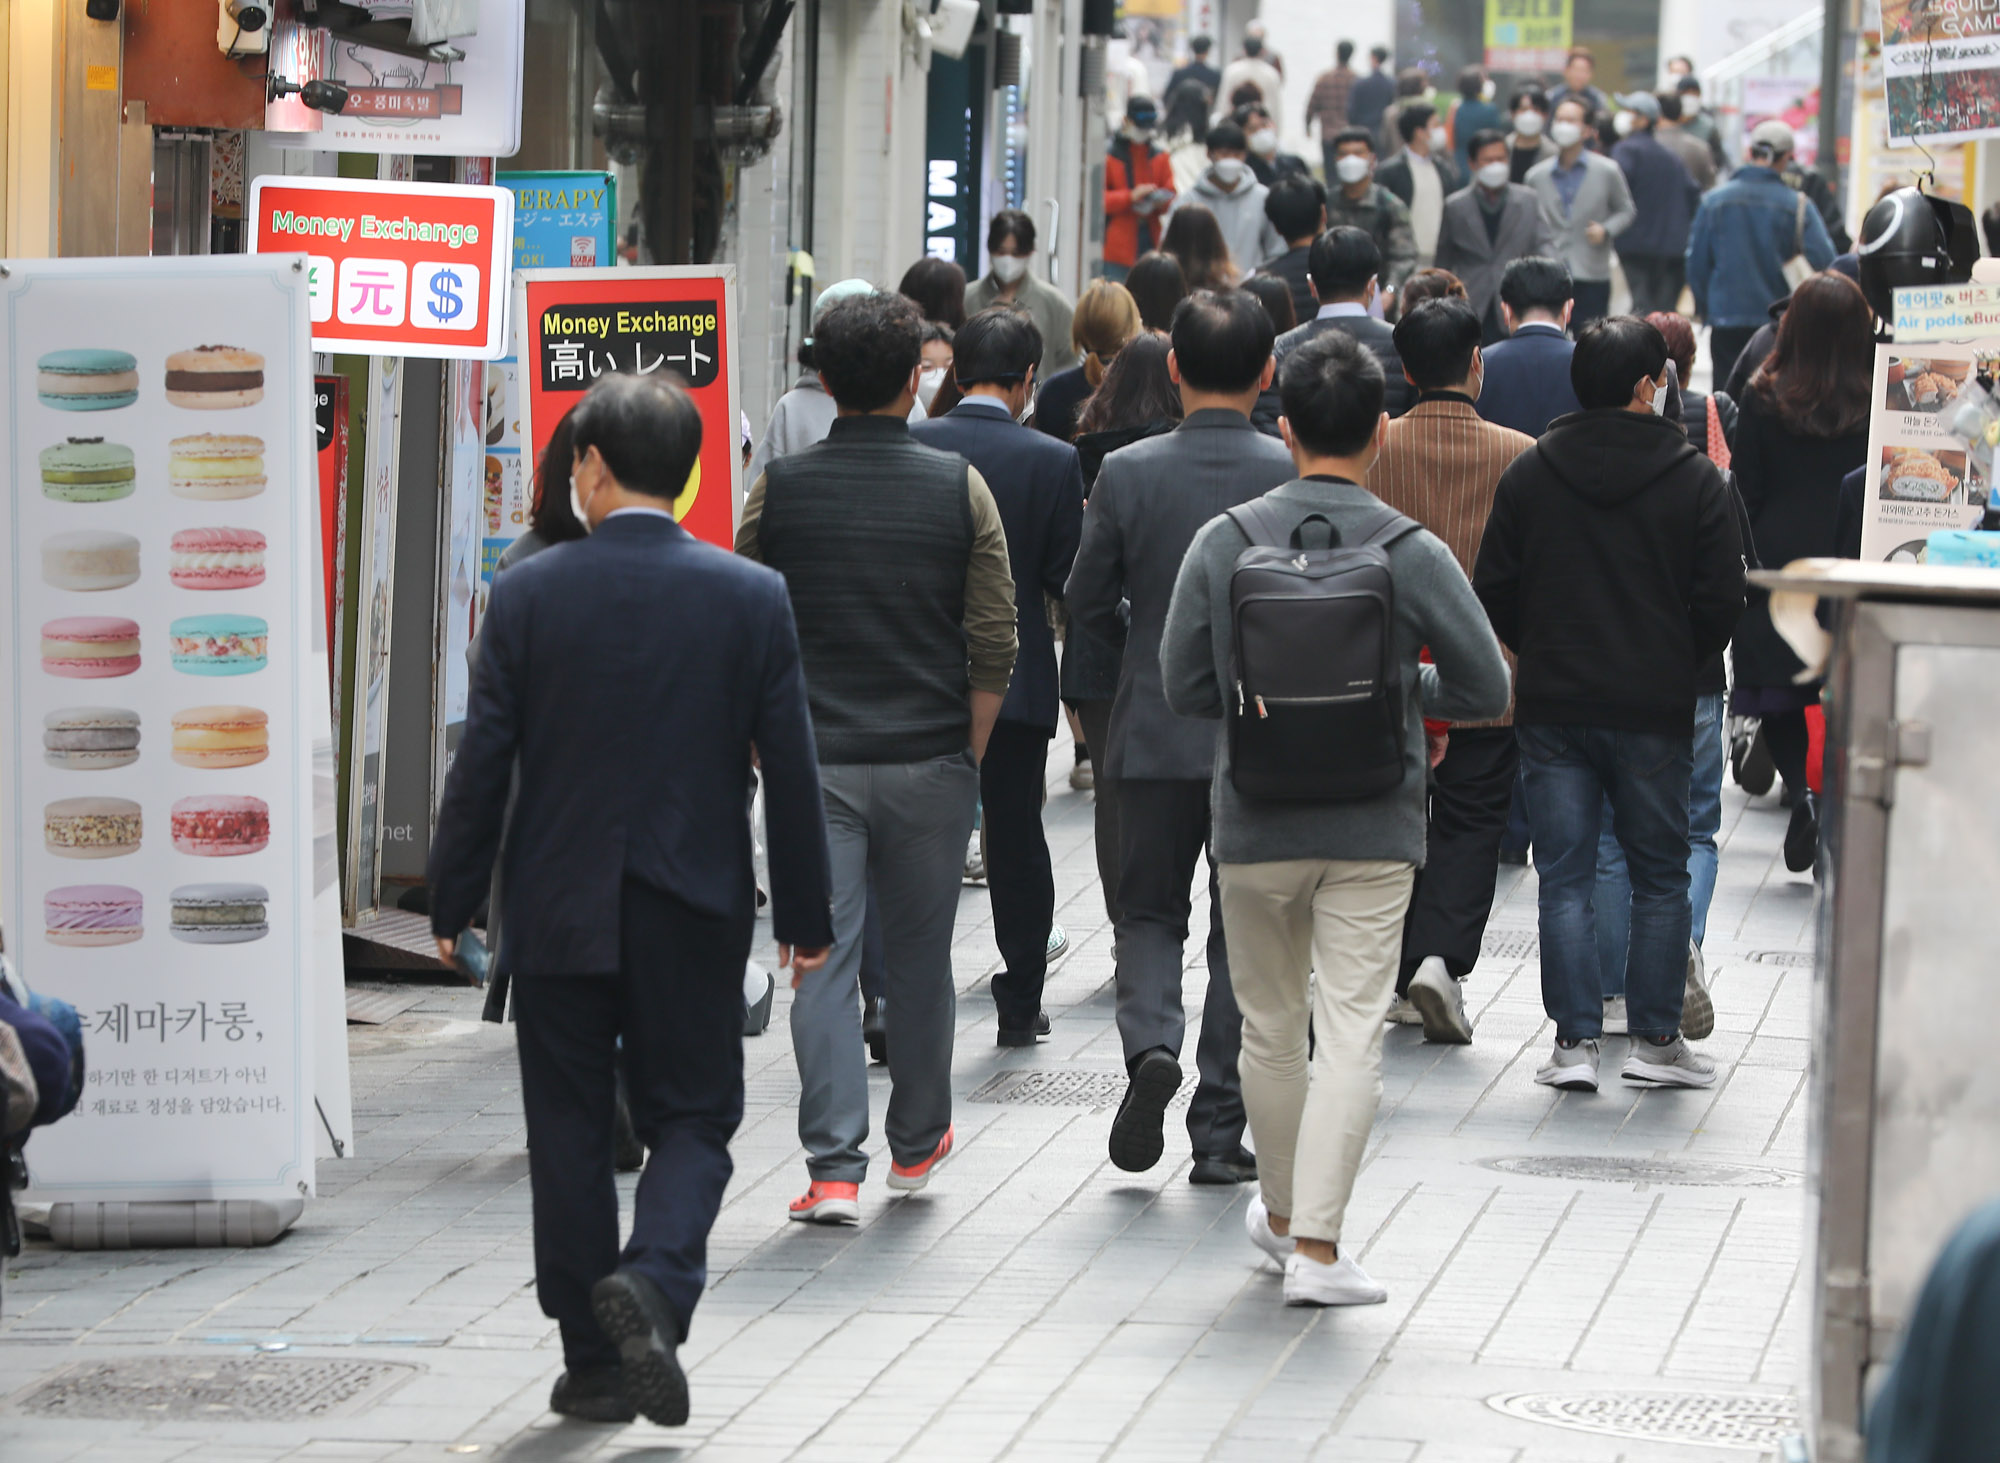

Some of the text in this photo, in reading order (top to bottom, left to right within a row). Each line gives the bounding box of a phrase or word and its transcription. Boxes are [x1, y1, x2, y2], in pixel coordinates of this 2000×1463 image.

[271, 209, 479, 249] Money Exchange
[350, 269, 395, 316] 元
[1959, 288, 1989, 306] 버즈
[544, 310, 717, 339] Money Exchange
[1897, 314, 1920, 329] Air
[143, 1069, 159, 1086] 한
[164, 1066, 230, 1085] 디저트가
[234, 1066, 267, 1084] 아닌
[92, 1098, 140, 1117] 재료로
[146, 1097, 194, 1116] 정성을
[199, 1094, 287, 1116] 담았습니다.
